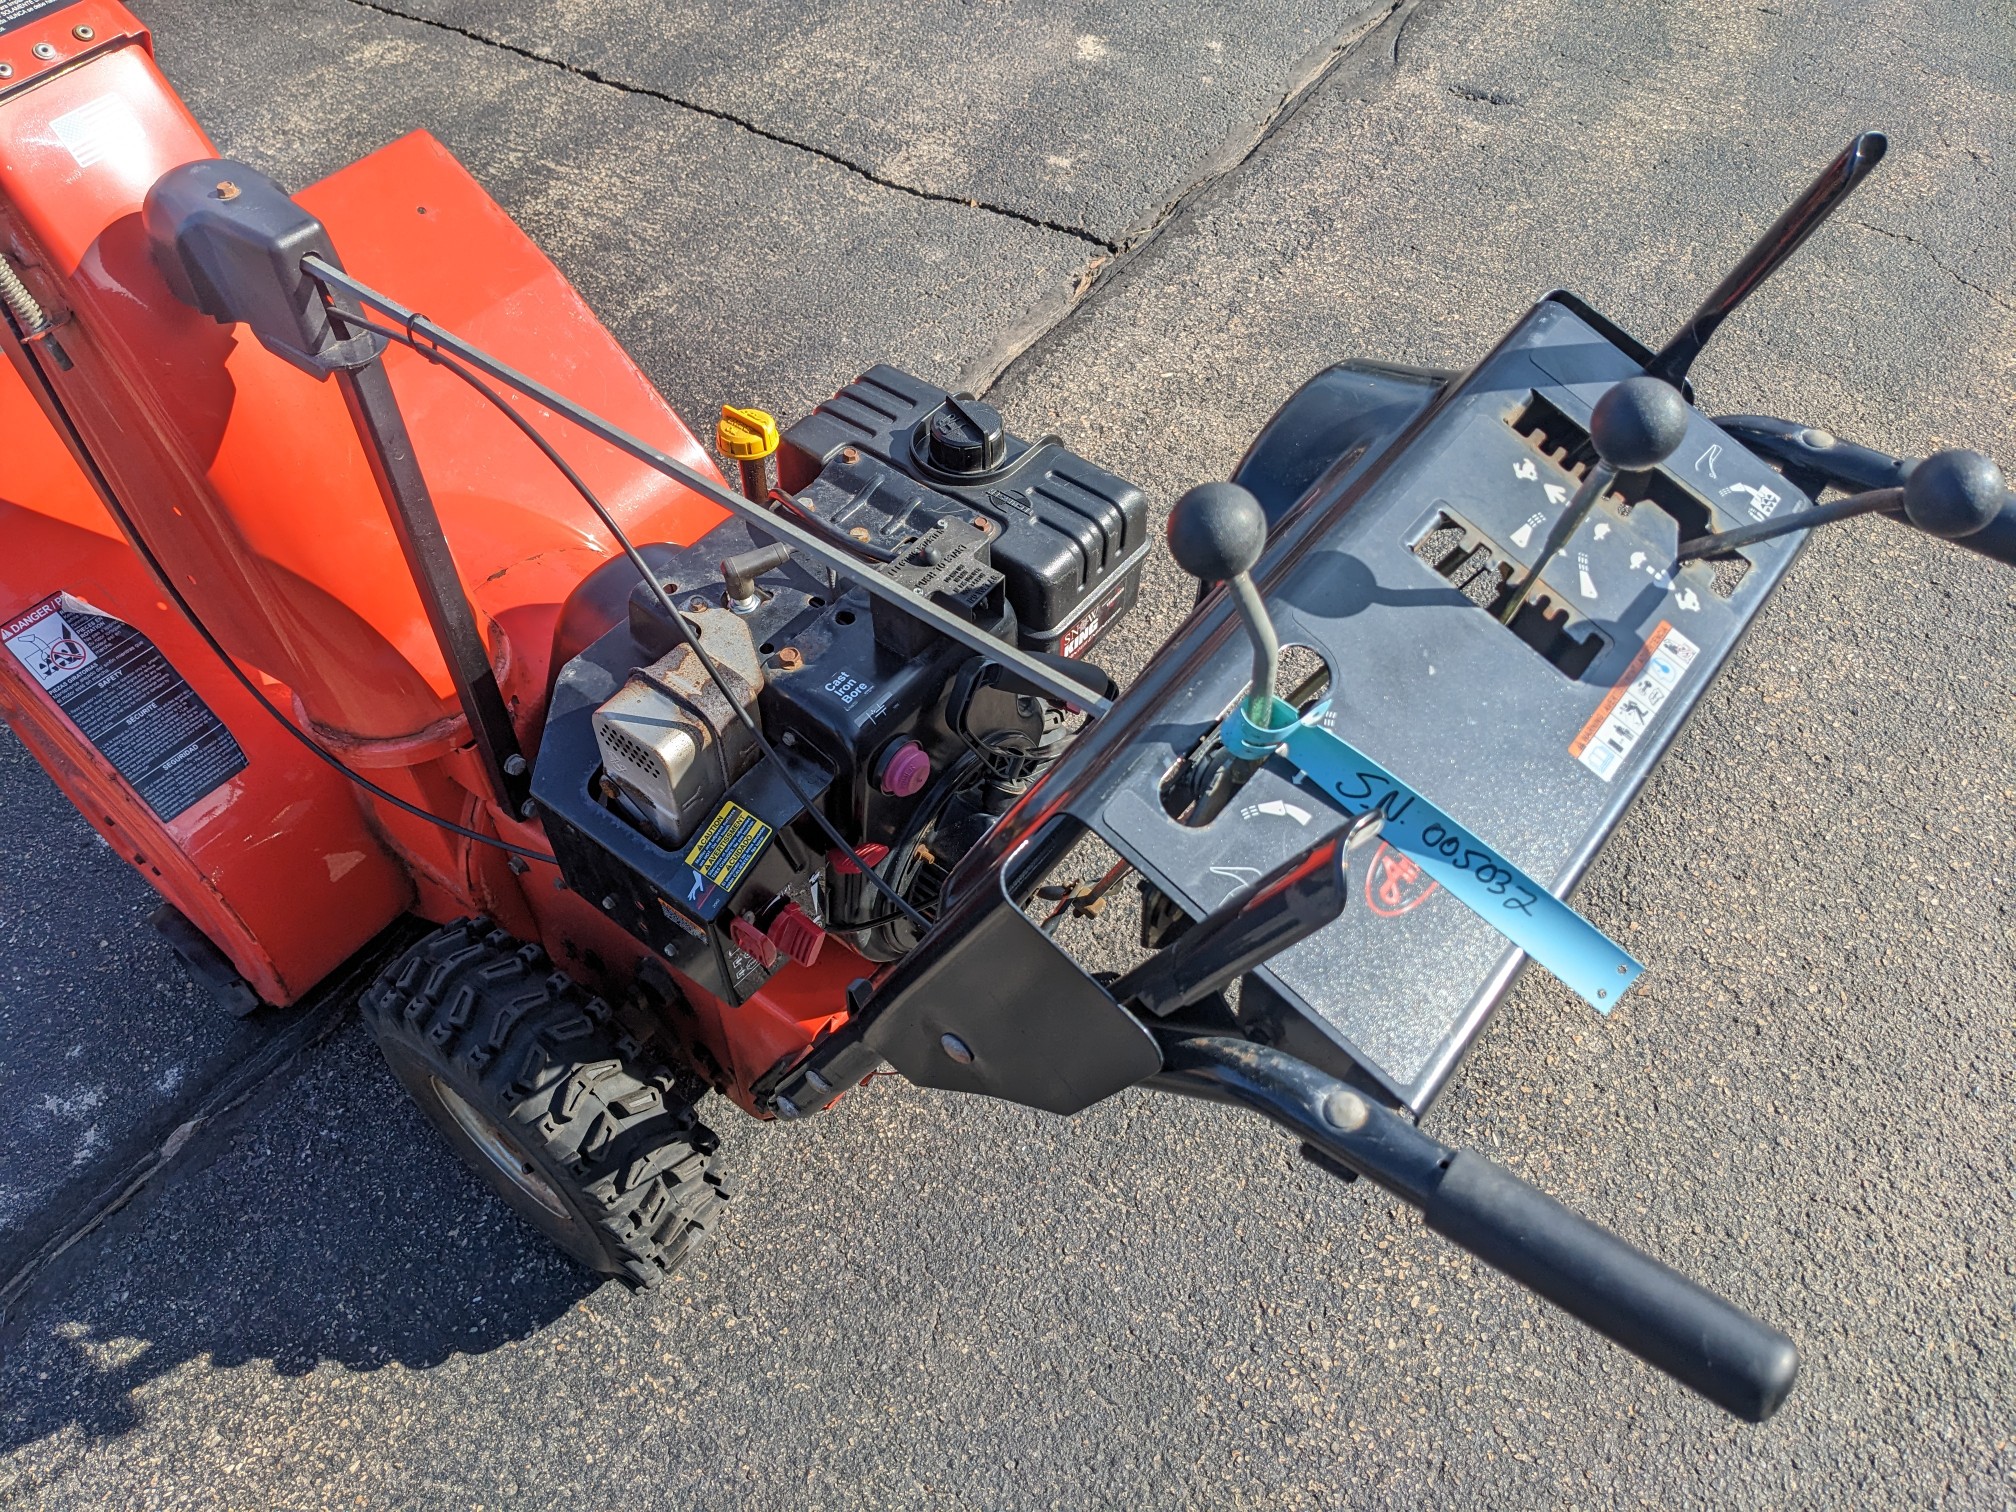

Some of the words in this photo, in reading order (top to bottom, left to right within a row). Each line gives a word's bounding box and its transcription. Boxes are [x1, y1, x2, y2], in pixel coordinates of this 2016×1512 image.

[10, 603, 52, 633] DANGER
[50, 601, 56, 609] /
[79, 620, 105, 639] ROTATION
[1064, 608, 1099, 644] SNOW
[1063, 619, 1099, 657] KING
[48, 681, 68, 695] PIEZAS
[67, 662, 98, 683] GIRATORIAS
[97, 669, 123, 689] SAFETY
[825, 671, 850, 692] Cast
[834, 678, 857, 698] Iron
[842, 683, 867, 703] Bore
[124, 700, 158, 725] SÉCURITÉ
[1579, 712, 1605, 742] WARNING
[161, 743, 199, 771] SEGURIDAD
[699, 815, 724, 845] CAUTION
[706, 814, 746, 864] AVERTISSMENT
[727, 833, 753, 865] CUIDADO
[1421, 822, 1538, 918] 005032
